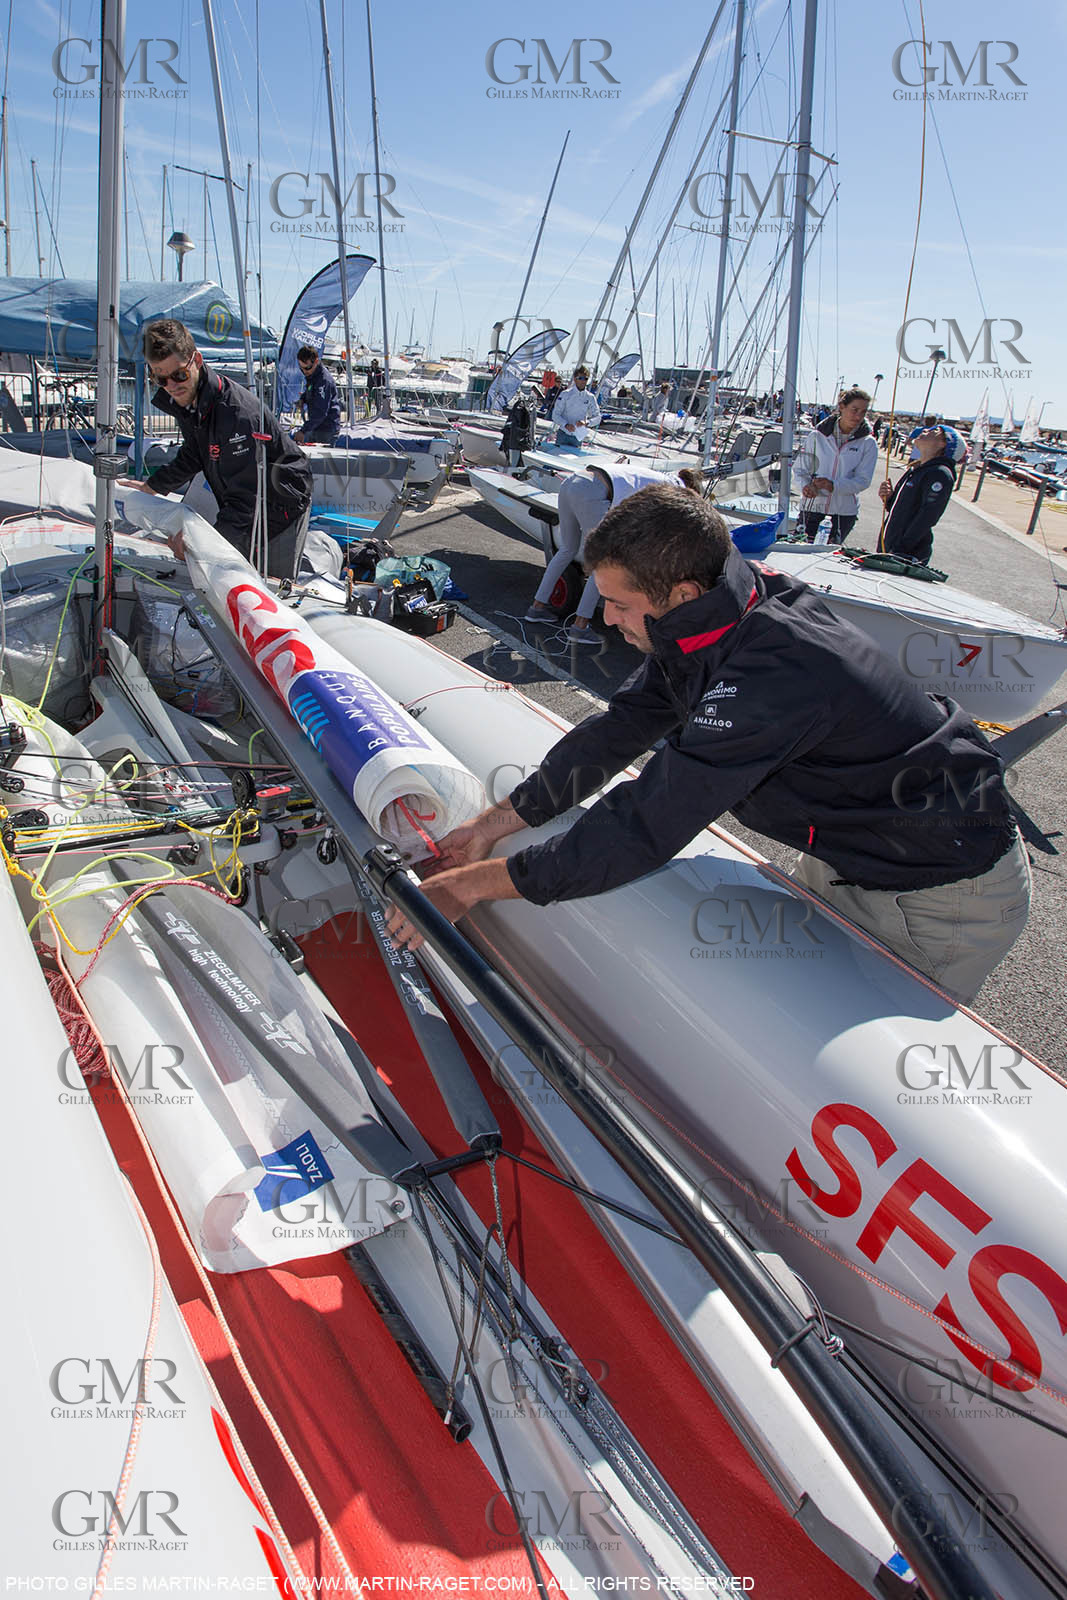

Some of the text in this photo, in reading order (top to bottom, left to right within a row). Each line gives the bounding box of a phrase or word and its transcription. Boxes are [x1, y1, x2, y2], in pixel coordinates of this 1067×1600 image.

[212, 313, 225, 334] 11
[292, 327, 324, 344] WORLD
[319, 673, 388, 750] BANQUE
[346, 674, 420, 745] POPULAIRE
[694, 716, 733, 728] ANAXAGO
[187, 948, 253, 1014] high technology
[204, 949, 262, 1007] ZIEGELMAYER
[296, 1142, 323, 1184] ZAOLI
[785, 1103, 1067, 1392] SFS
